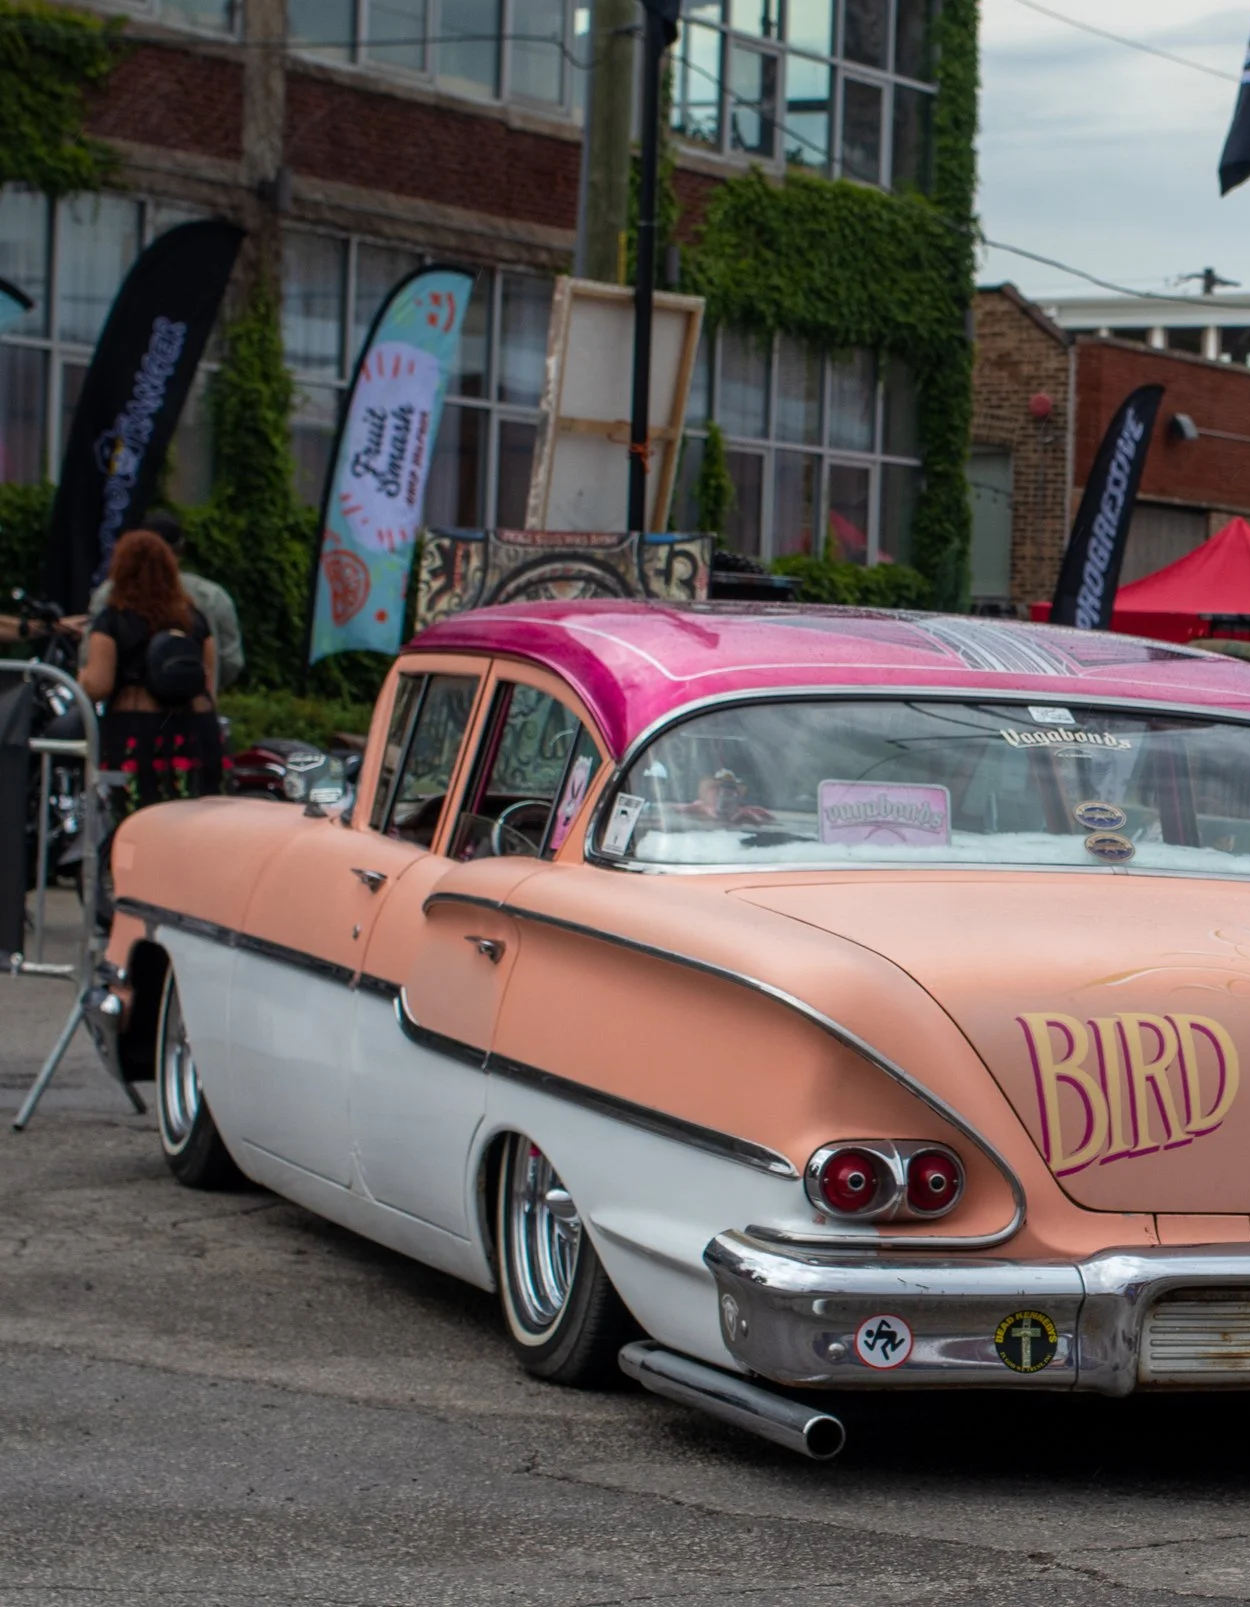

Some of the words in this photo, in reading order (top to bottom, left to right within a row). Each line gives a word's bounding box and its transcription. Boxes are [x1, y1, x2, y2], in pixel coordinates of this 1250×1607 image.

[351, 405, 388, 480] Fruit
[376, 401, 415, 498] Smash
[1074, 406, 1145, 630] PROGRESSIVE
[1000, 727, 1132, 750] Vagabonds
[1015, 1012, 1240, 1178] BIRD
